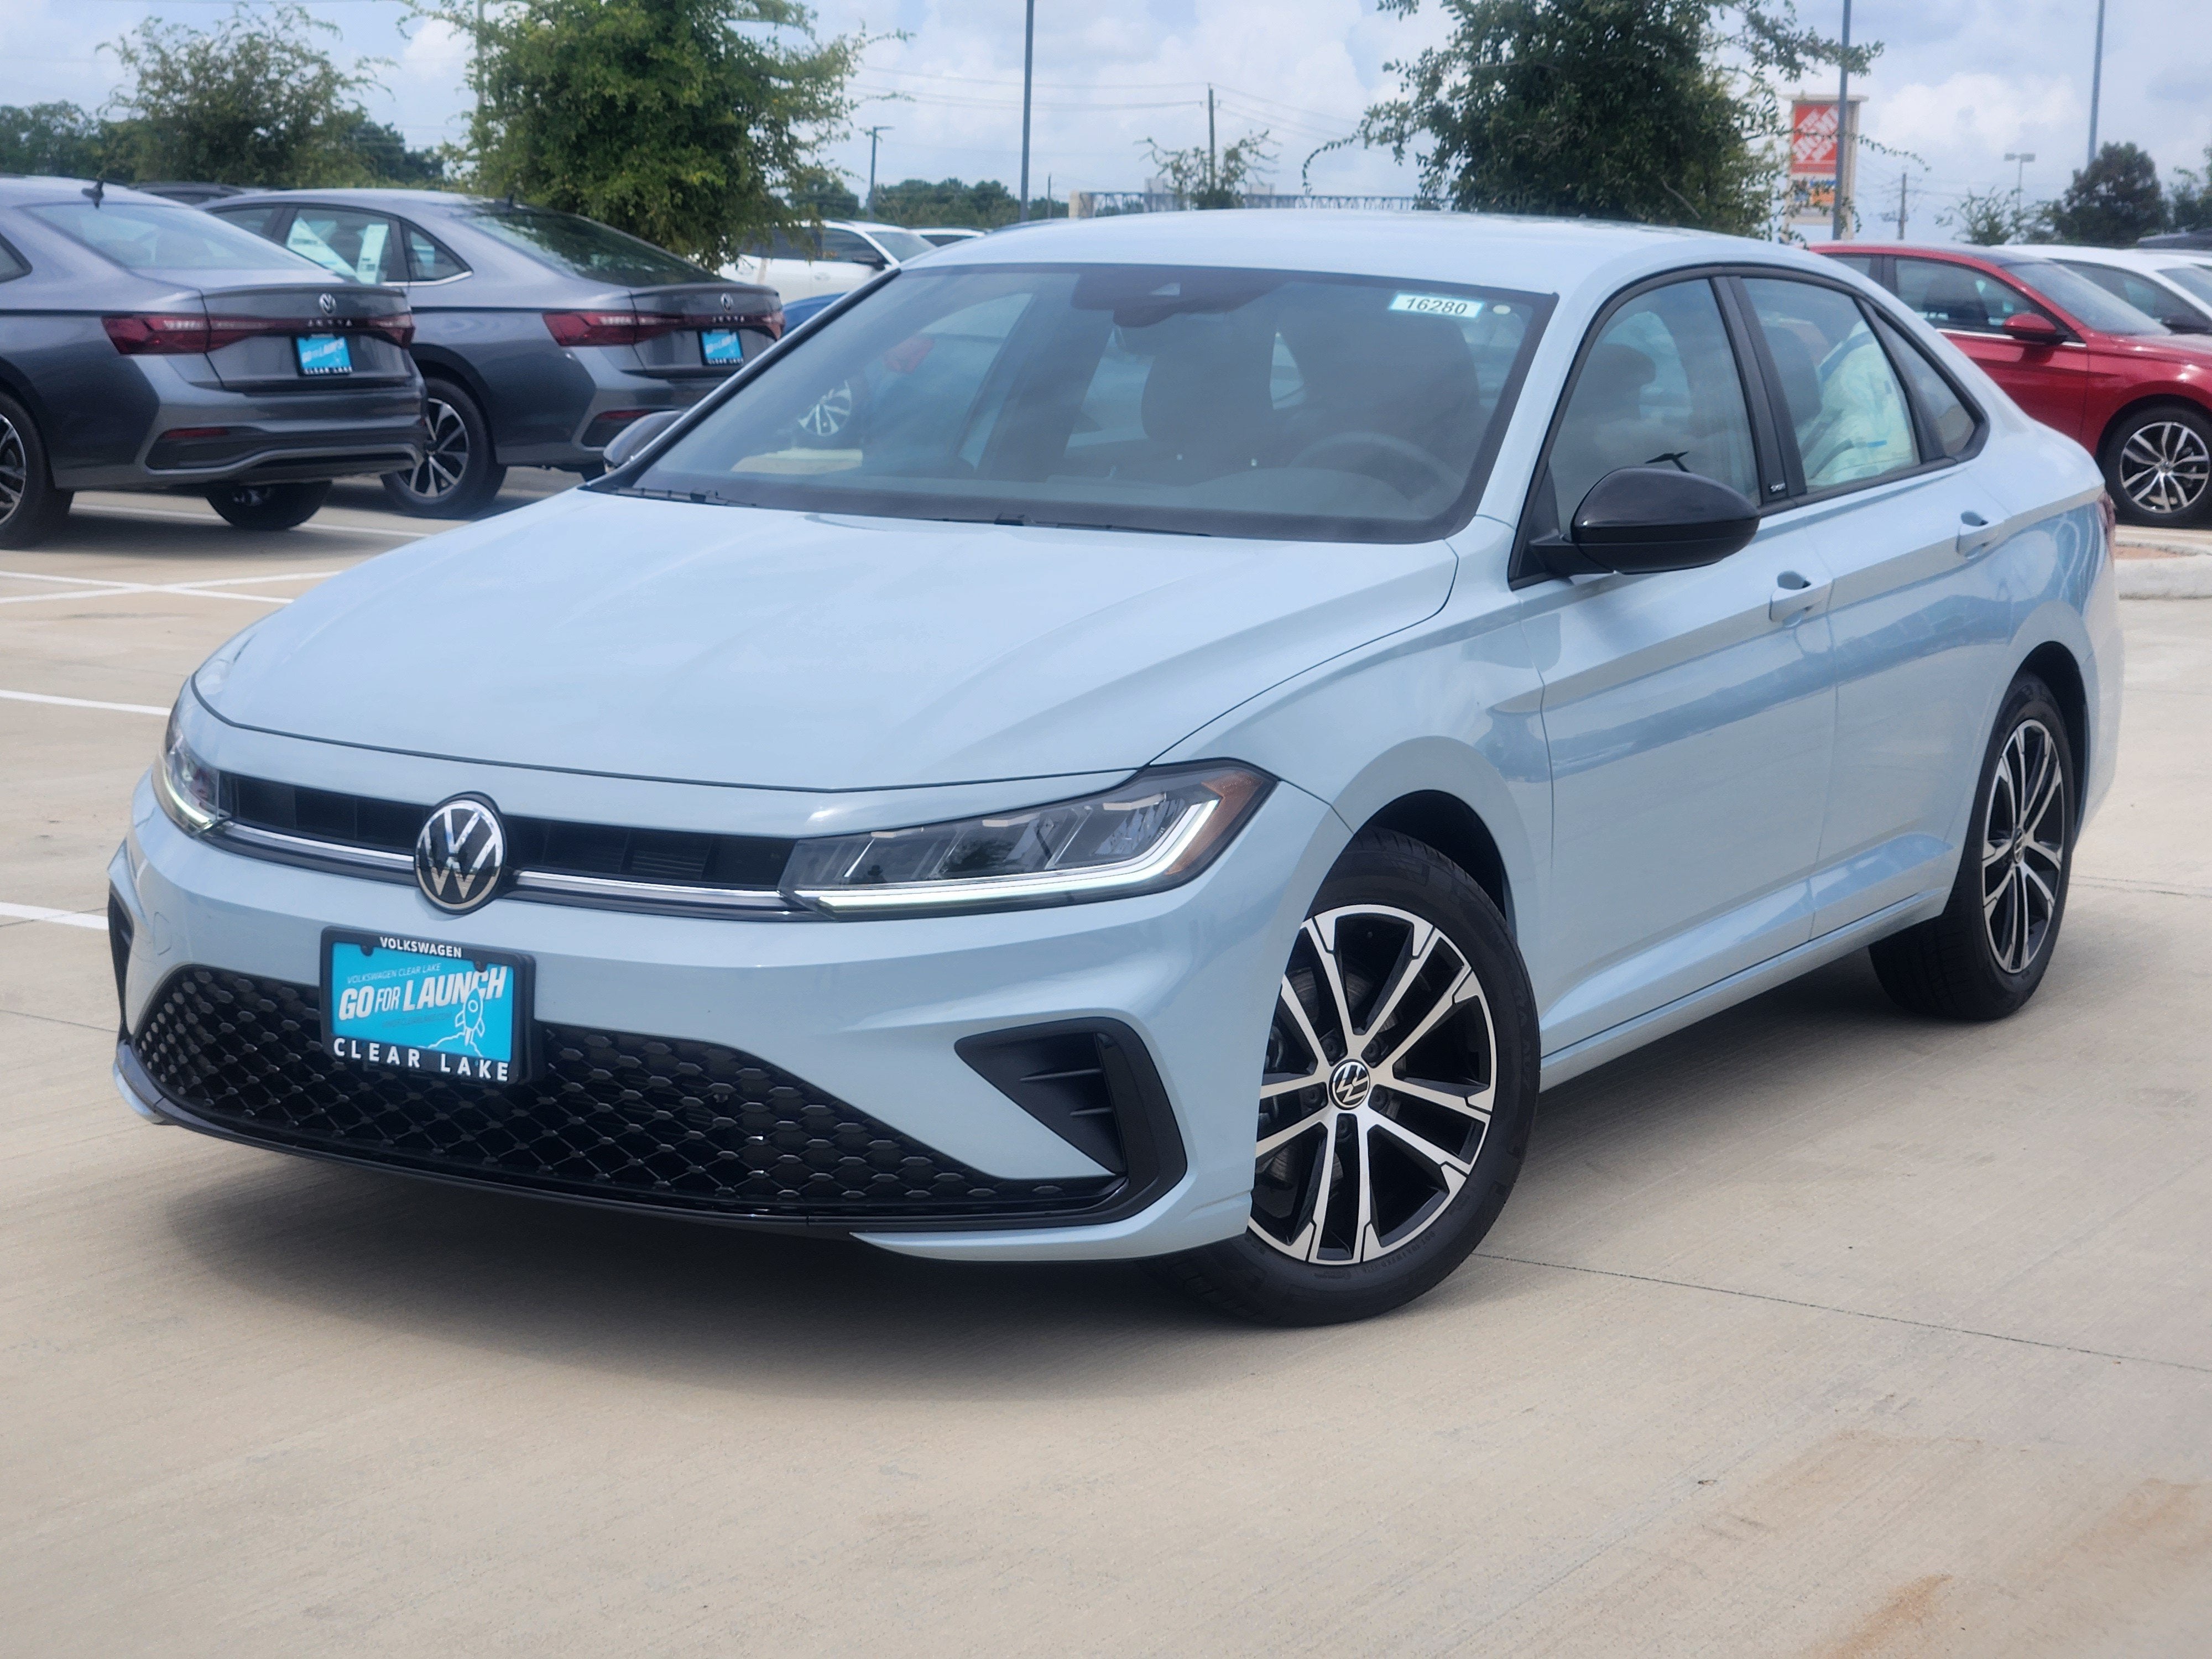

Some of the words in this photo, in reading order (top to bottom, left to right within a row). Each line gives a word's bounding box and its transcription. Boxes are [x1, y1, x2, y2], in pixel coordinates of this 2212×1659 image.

[1406, 298, 1468, 315] 16280
[380, 936, 462, 958] VOLKSWAGEN
[347, 969, 397, 984] VOLKSWAGEN
[398, 966, 421, 977] CLEAR
[422, 963, 442, 973] LAKE
[338, 985, 375, 1020] GO
[374, 986, 401, 1013] FOR
[403, 966, 507, 1011] LAUNCH
[333, 1037, 420, 1068] CLEAR
[441, 1053, 509, 1082] LAKE
